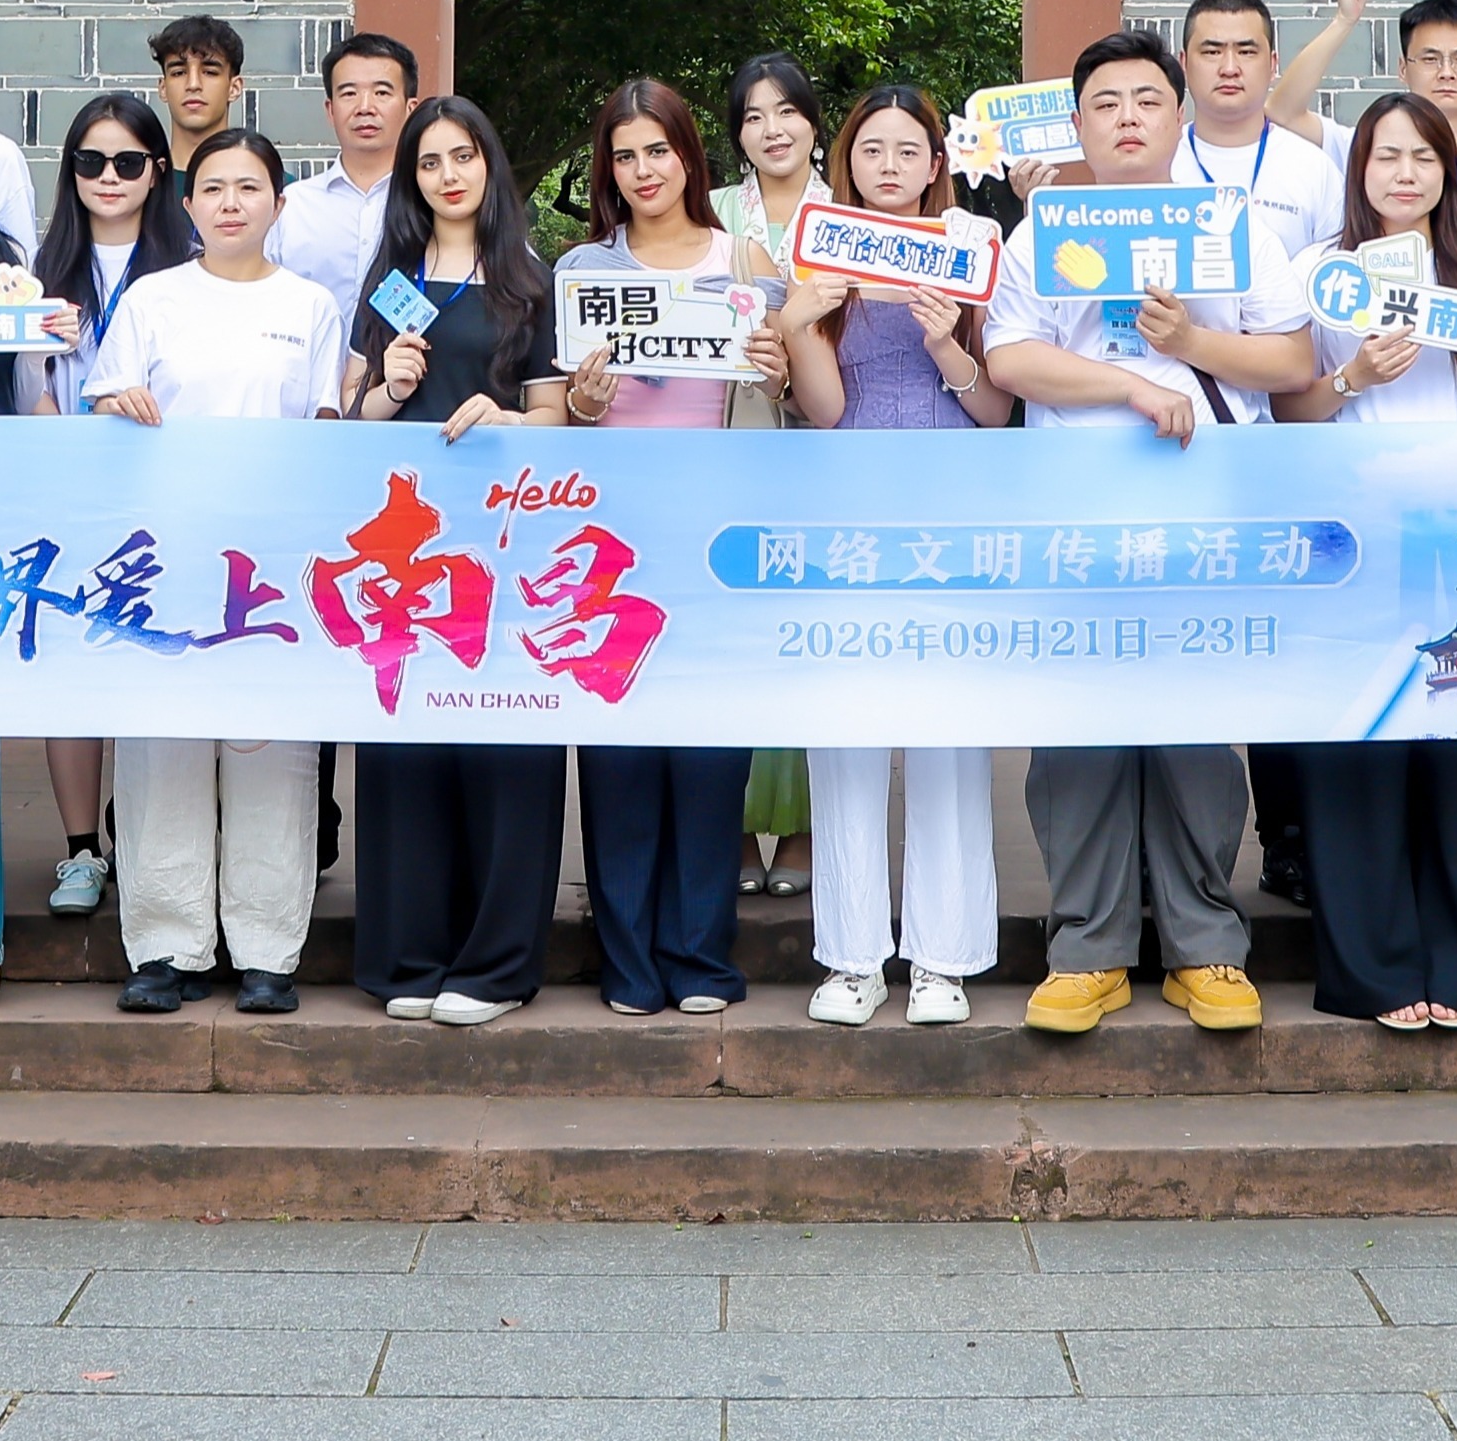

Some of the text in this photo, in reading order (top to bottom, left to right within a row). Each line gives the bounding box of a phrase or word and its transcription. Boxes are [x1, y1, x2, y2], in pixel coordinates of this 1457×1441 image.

[1020, 122, 1076, 153] 南昌
[1038, 203, 1190, 227] Welcome to
[1130, 235, 1236, 292] 南昌
[1368, 251, 1413, 269] CALL
[577, 286, 659, 327] 南昌
[486, 467, 598, 550] Hello
[756, 524, 1313, 585] 网络文明传播活动
[777, 613, 1280, 662] 2026年09月21日-23日
[426, 691, 560, 711] NAN CHANG
